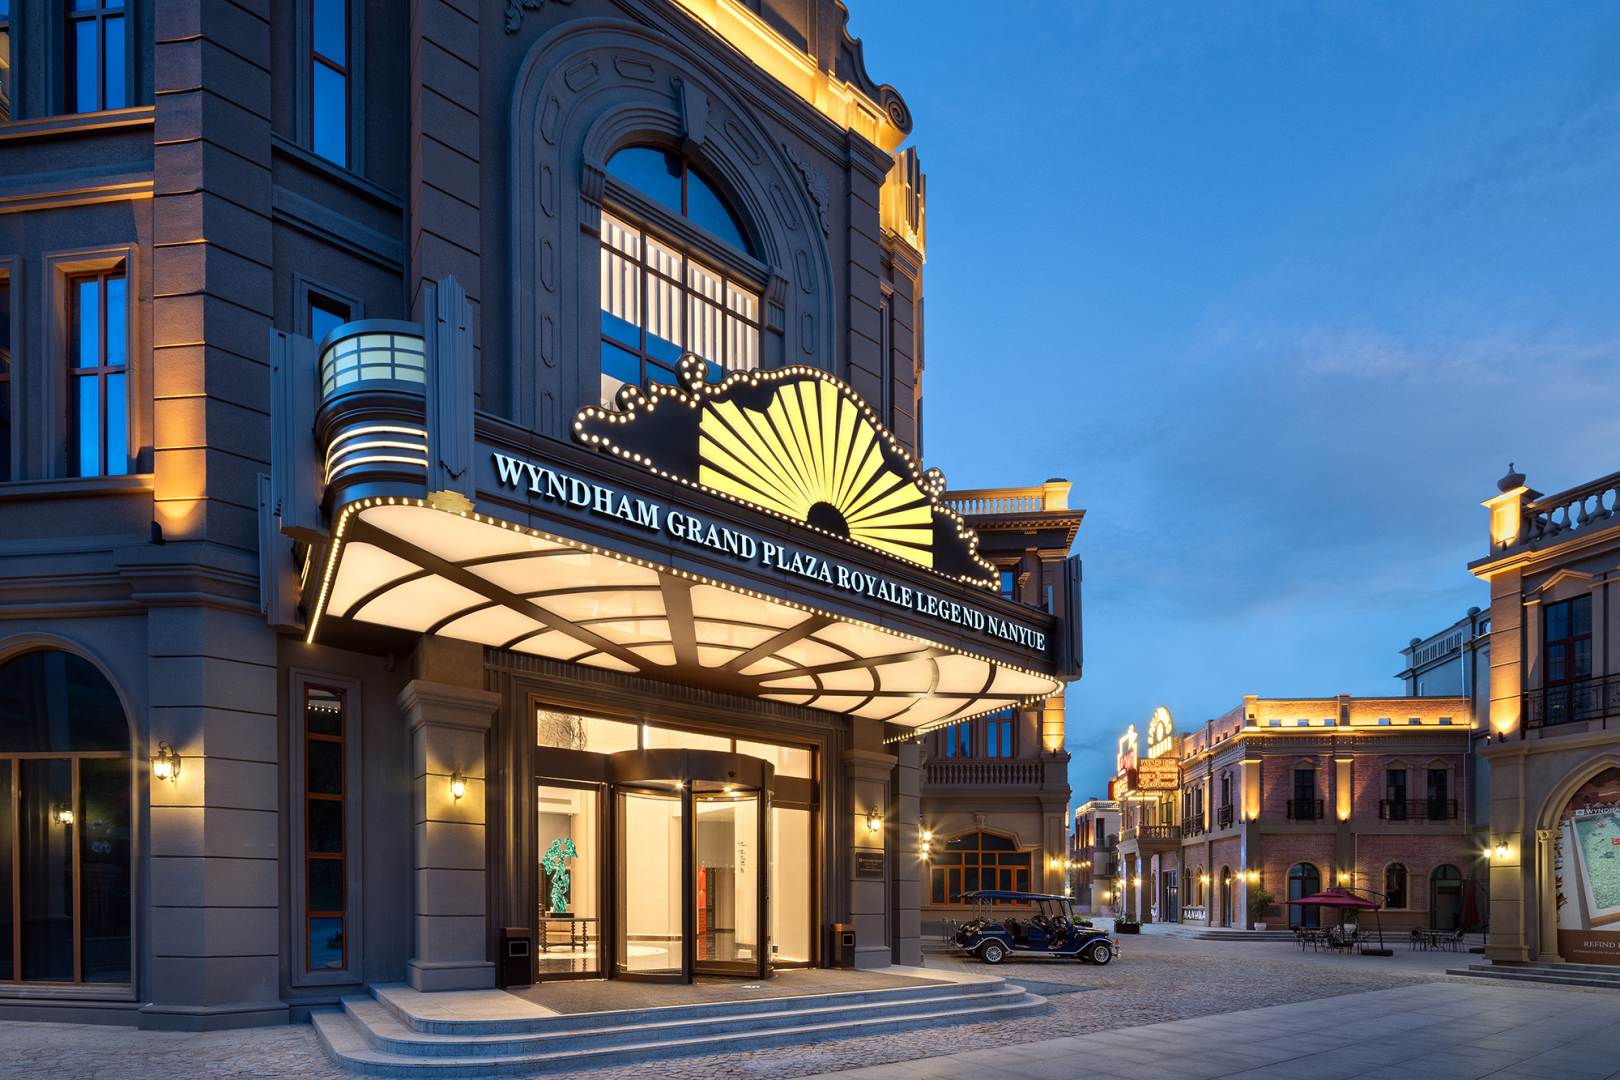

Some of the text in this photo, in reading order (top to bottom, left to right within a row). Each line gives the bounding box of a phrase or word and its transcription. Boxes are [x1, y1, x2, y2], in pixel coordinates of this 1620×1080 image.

[493, 452, 1046, 651] WYNDHAM GRAND PLAZA ROYALE LEGEND NANYUE
